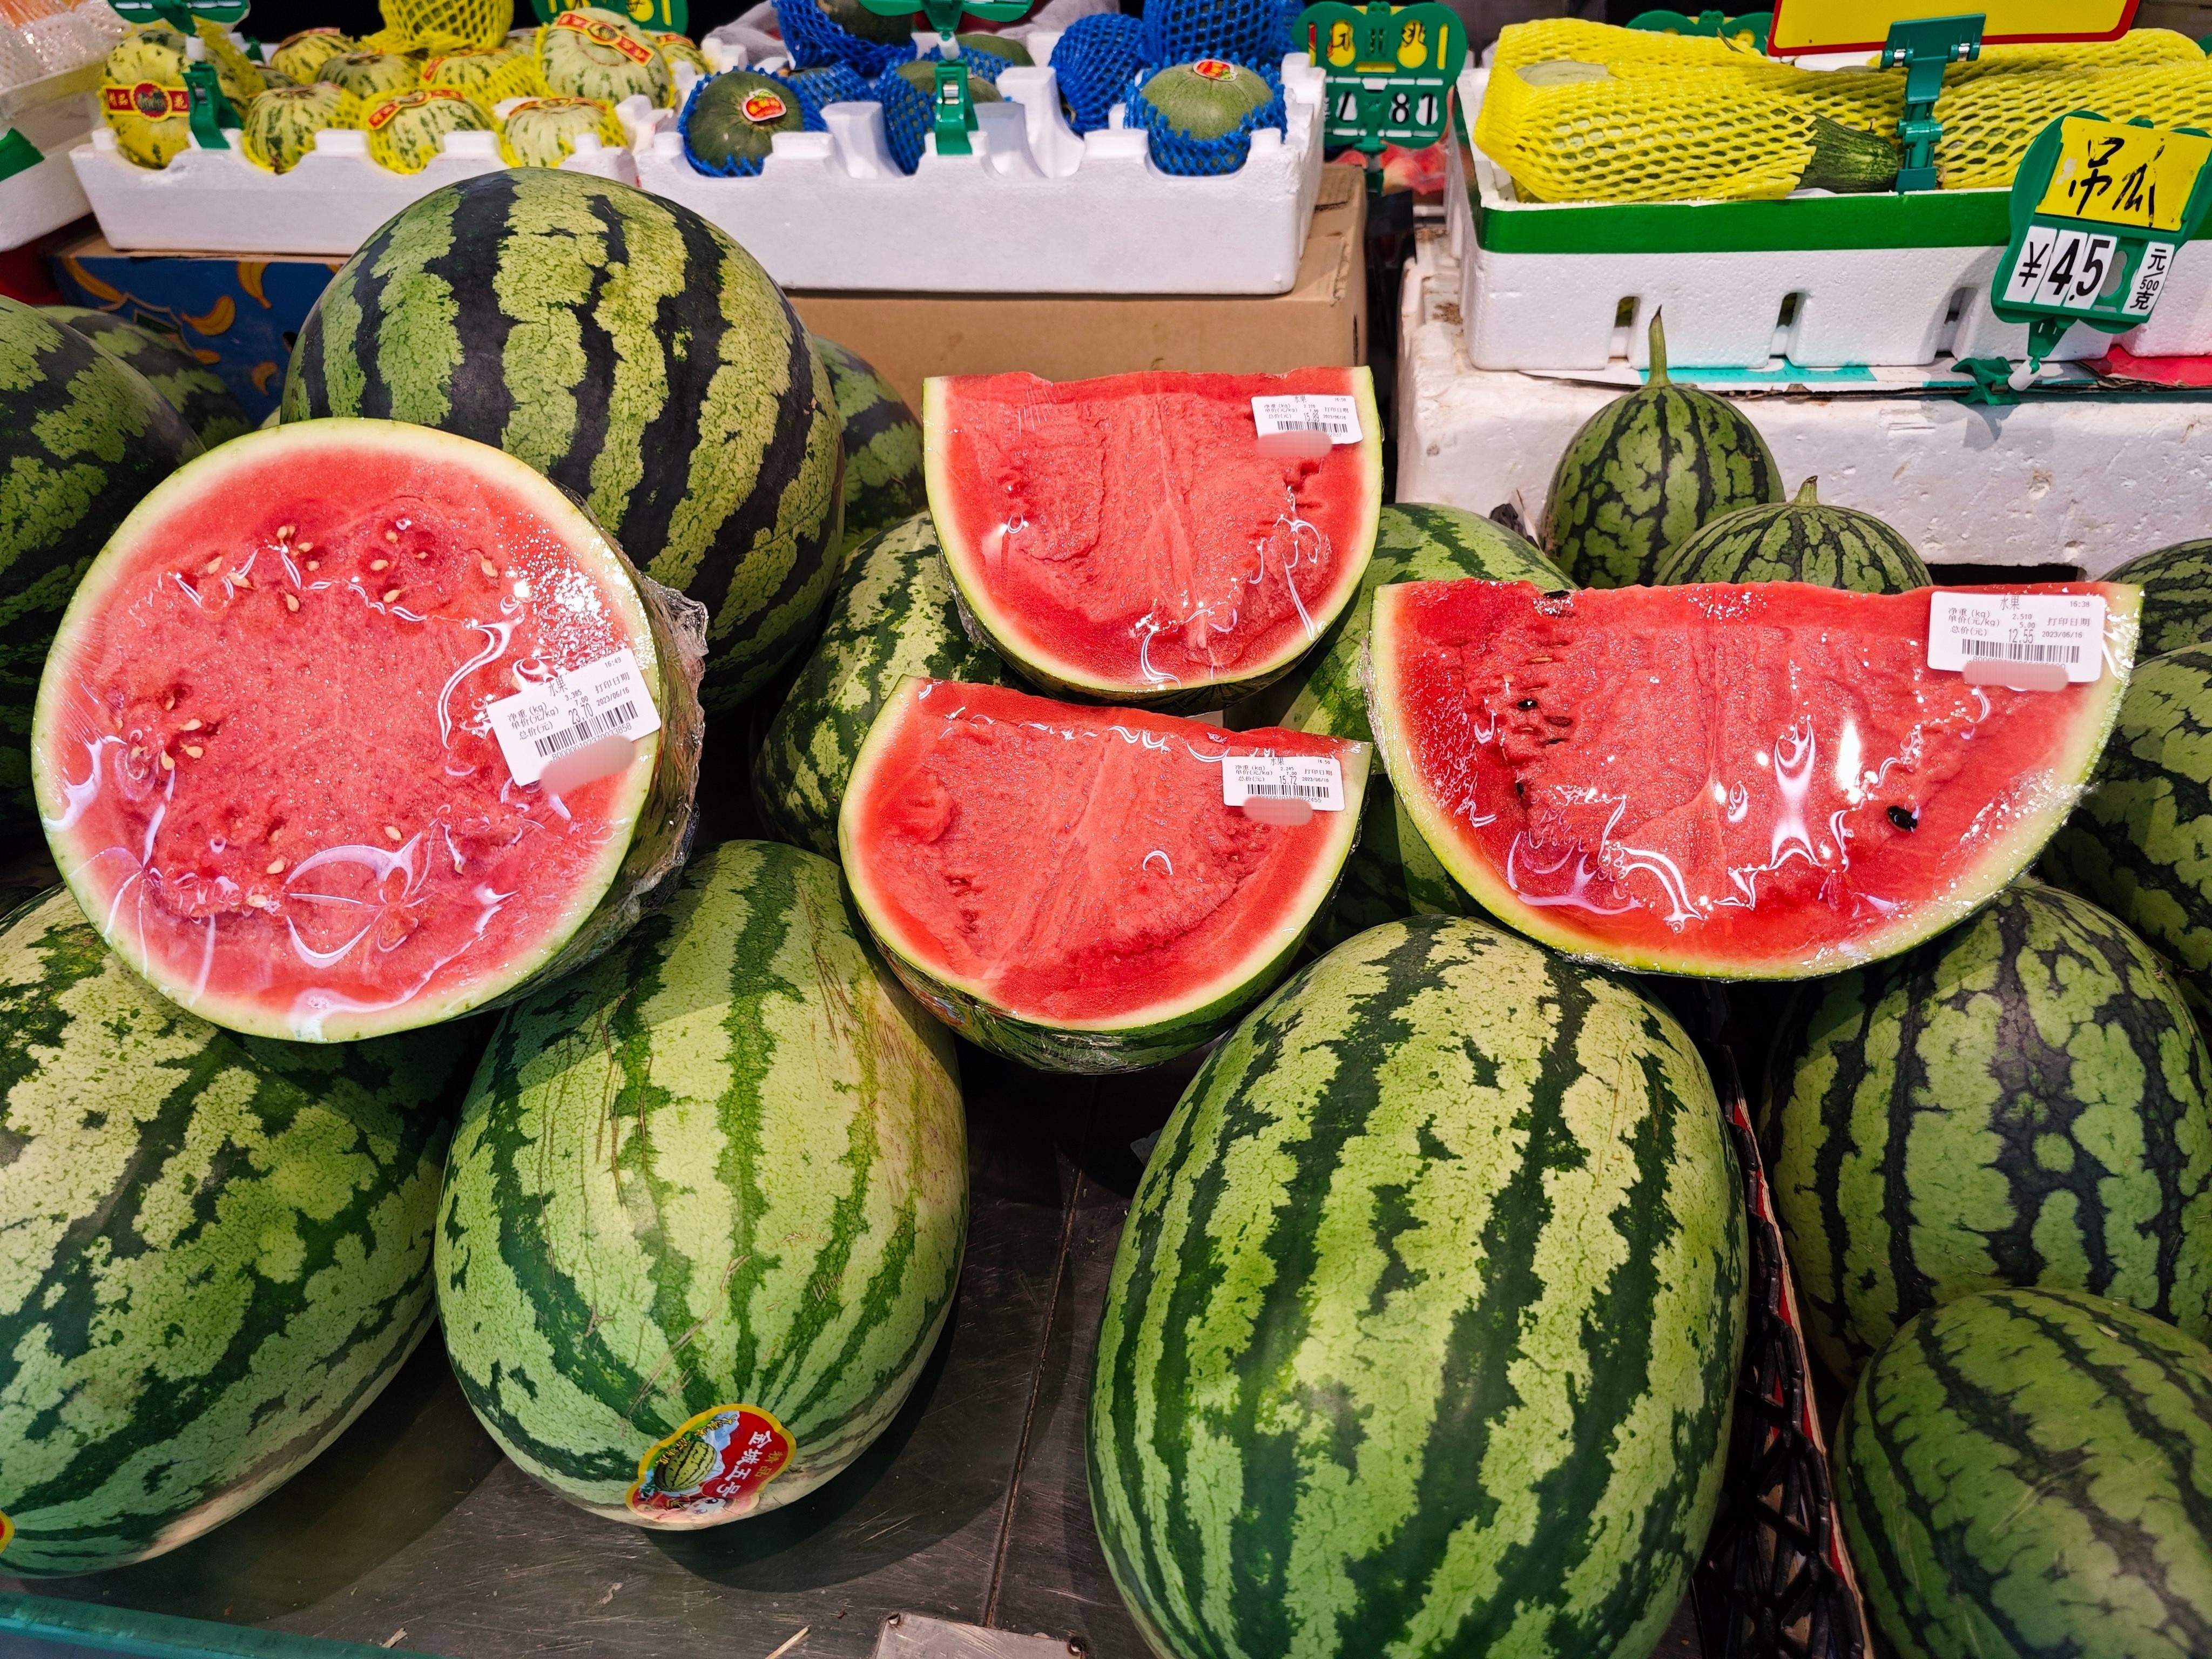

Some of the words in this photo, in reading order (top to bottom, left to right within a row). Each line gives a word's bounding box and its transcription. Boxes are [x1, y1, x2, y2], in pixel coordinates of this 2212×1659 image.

[2068, 136, 2166, 228] 吊瓜
[1303, 413, 1320, 422] 15.89
[2000, 595, 2020, 611] 水果
[2069, 600, 2090, 608] 16:38
[1971, 609, 1992, 619] (kg)
[2047, 617, 2091, 628] 打印日期
[1950, 625, 1988, 637] 总价(元)
[2008, 629, 2034, 644] 12.55
[2041, 630, 2083, 639] 2023/06/16
[604, 656, 622, 669] 16:49
[548, 676, 569, 697] 水果
[595, 672, 631, 694] 打印日期
[529, 702, 548, 716] (kg)
[565, 689, 583, 702] 3.385
[575, 696, 589, 706] 7.00
[596, 687, 630, 707] 2023/06/16
[568, 703, 594, 725] 23.70
[1270, 757, 1285, 766] 水果
[1279, 775, 1298, 785] 15.72
